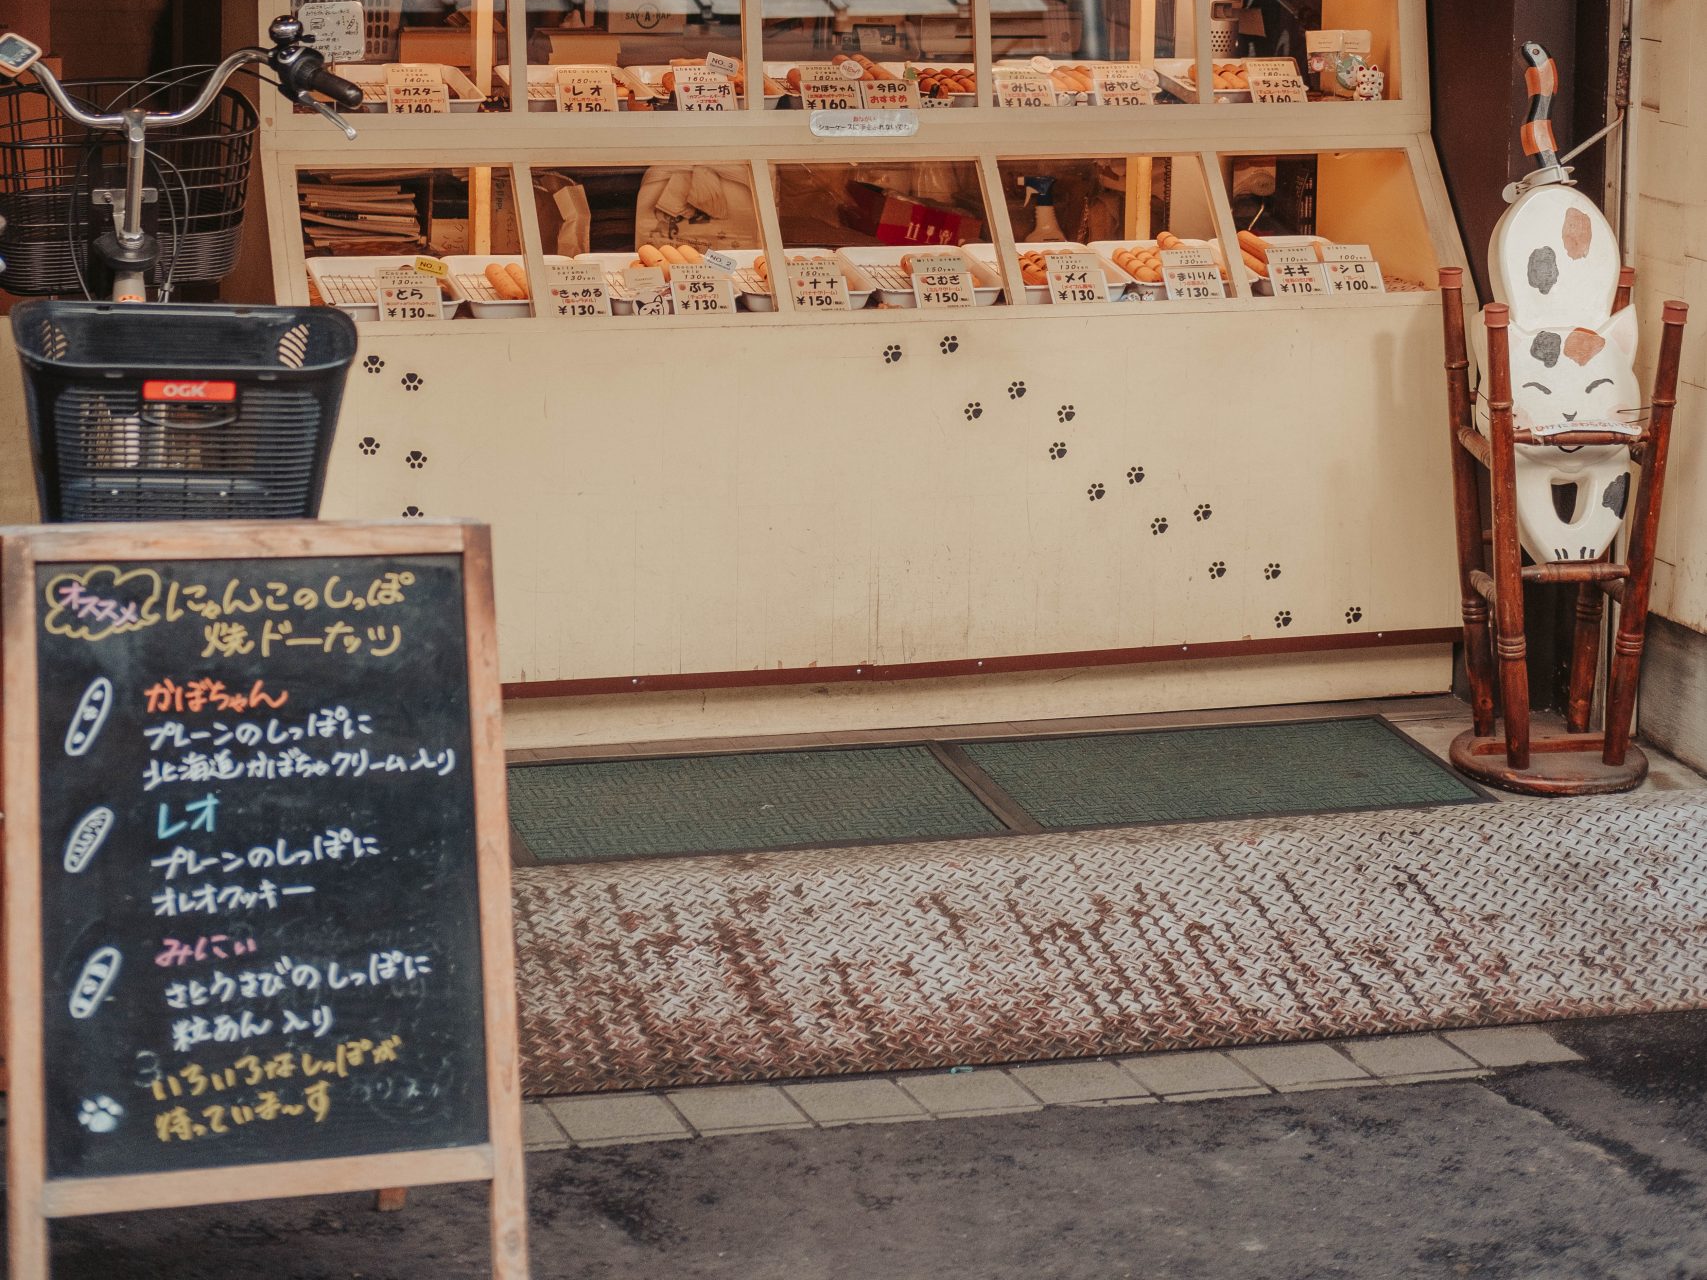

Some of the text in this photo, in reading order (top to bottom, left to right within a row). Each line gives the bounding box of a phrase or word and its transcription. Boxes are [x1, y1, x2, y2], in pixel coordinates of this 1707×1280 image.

[877, 83, 908, 93] 今月の
[1104, 81, 1141, 91] はやと
[1262, 79, 1301, 88] ちょこ丸
[401, 87, 441, 97] カスター
[572, 85, 602, 96] レオ
[806, 99, 847, 109] ¥160
[869, 95, 908, 104] おすすめ
[1005, 98, 1042, 108] ¥140
[1103, 97, 1139, 106] ¥150
[395, 104, 432, 113] ¥140
[564, 102, 602, 112] ¥150
[1284, 265, 1310, 277] キキ
[1339, 264, 1365, 274] シロ
[926, 275, 960, 286] こむぎ
[1064, 272, 1088, 283] メイ
[1176, 272, 1217, 281] まりりん
[1280, 282, 1312, 293] ¥110
[1334, 280, 1368, 291] ¥100
[396, 288, 423, 300] とら
[559, 288, 602, 298] きゃめる
[923, 292, 959, 303] ¥150
[1058, 290, 1095, 301] ¥130
[1175, 287, 1209, 298] ¥130
[681, 300, 718, 311] ¥130
[796, 296, 832, 306] ¥150
[387, 307, 425, 318] ¥130
[558, 305, 595, 315] ¥130
[163, 384, 206, 397] OGK
[166, 571, 415, 622] にゃんこのしっぽ
[59, 581, 140, 627] オススメ
[144, 678, 289, 713] かぼちゃん
[144, 707, 372, 752] プレーンのしっぽに
[156, 792, 221, 839] レオ
[151, 829, 380, 882] プレーンのしっぽに
[151, 879, 316, 917] オレオクッキー
[151, 1035, 402, 1101] いろいろなしっぽが
